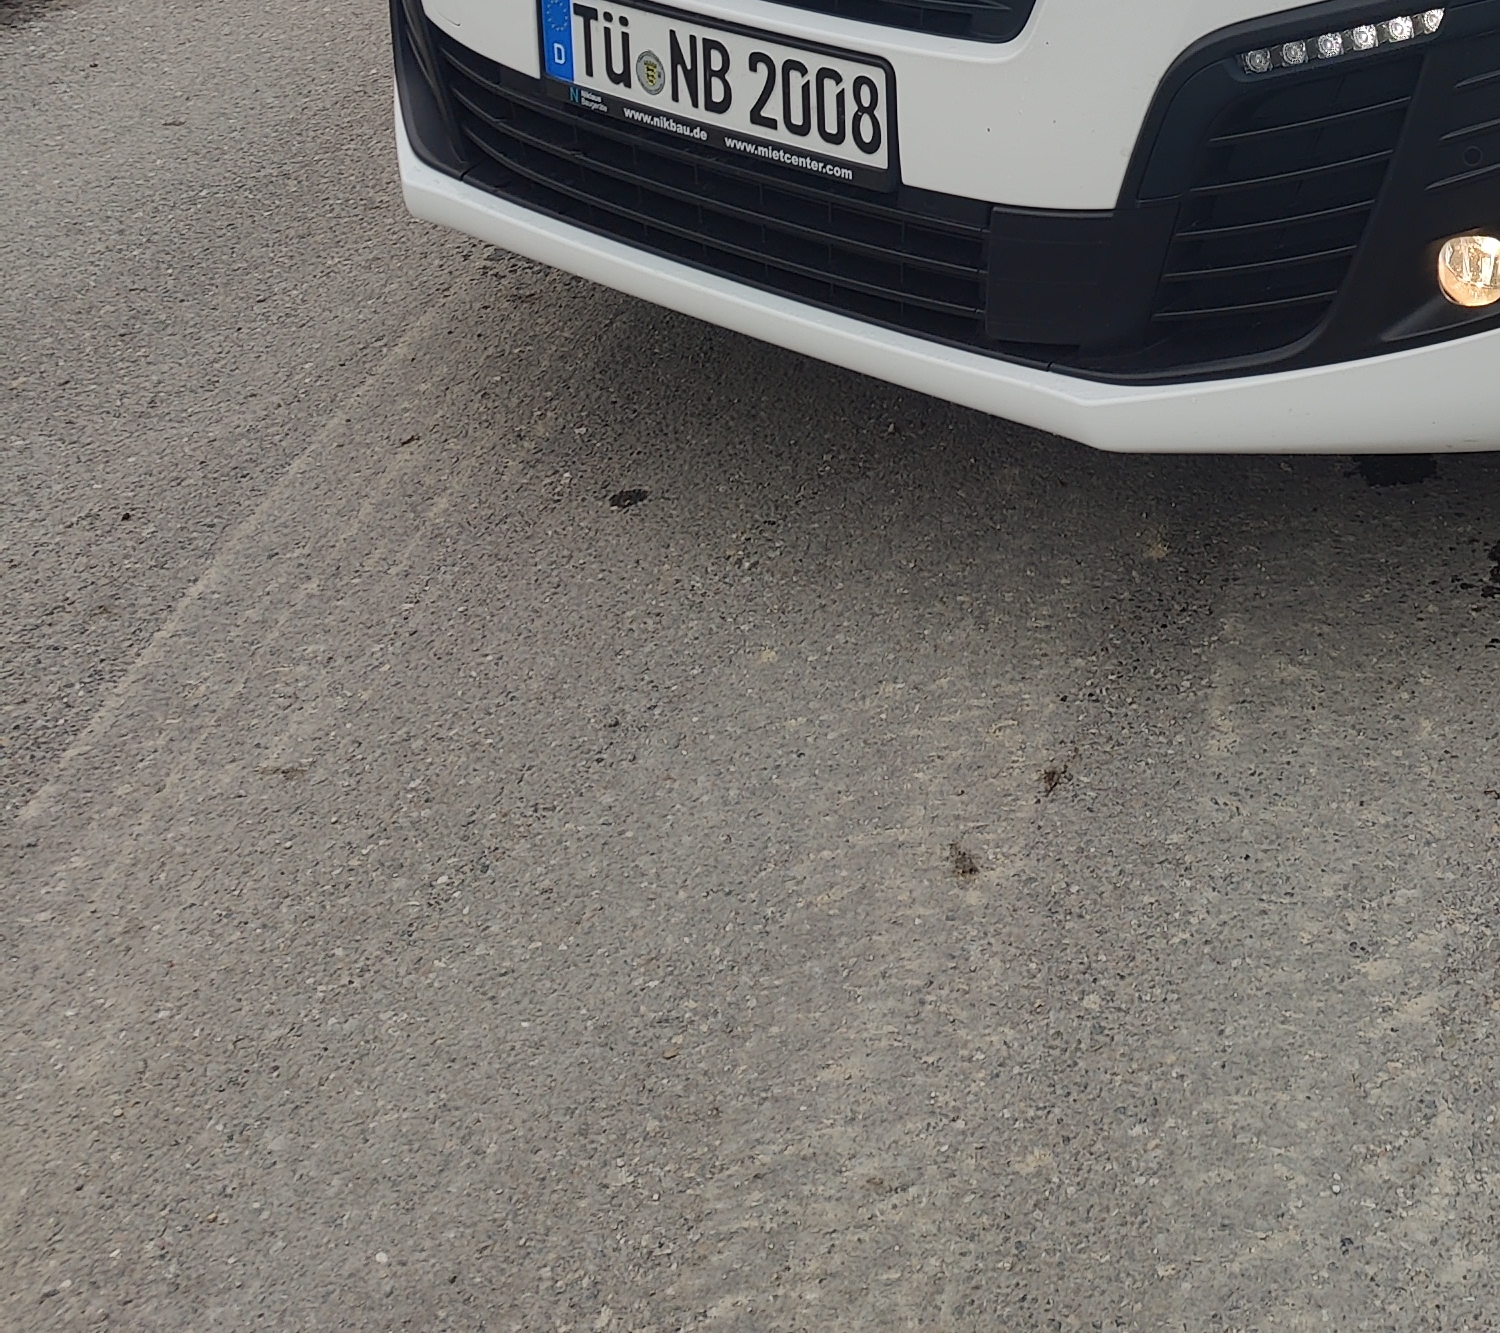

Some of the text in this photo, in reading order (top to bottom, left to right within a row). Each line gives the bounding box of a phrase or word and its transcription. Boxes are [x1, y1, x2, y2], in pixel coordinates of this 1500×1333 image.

[553, 42, 566, 65] D
[570, 86, 578, 103] N
[573, 2, 882, 155] TÜ NB 2008
[623, 107, 853, 181] www.nikbau.de www.mietcenter.com
